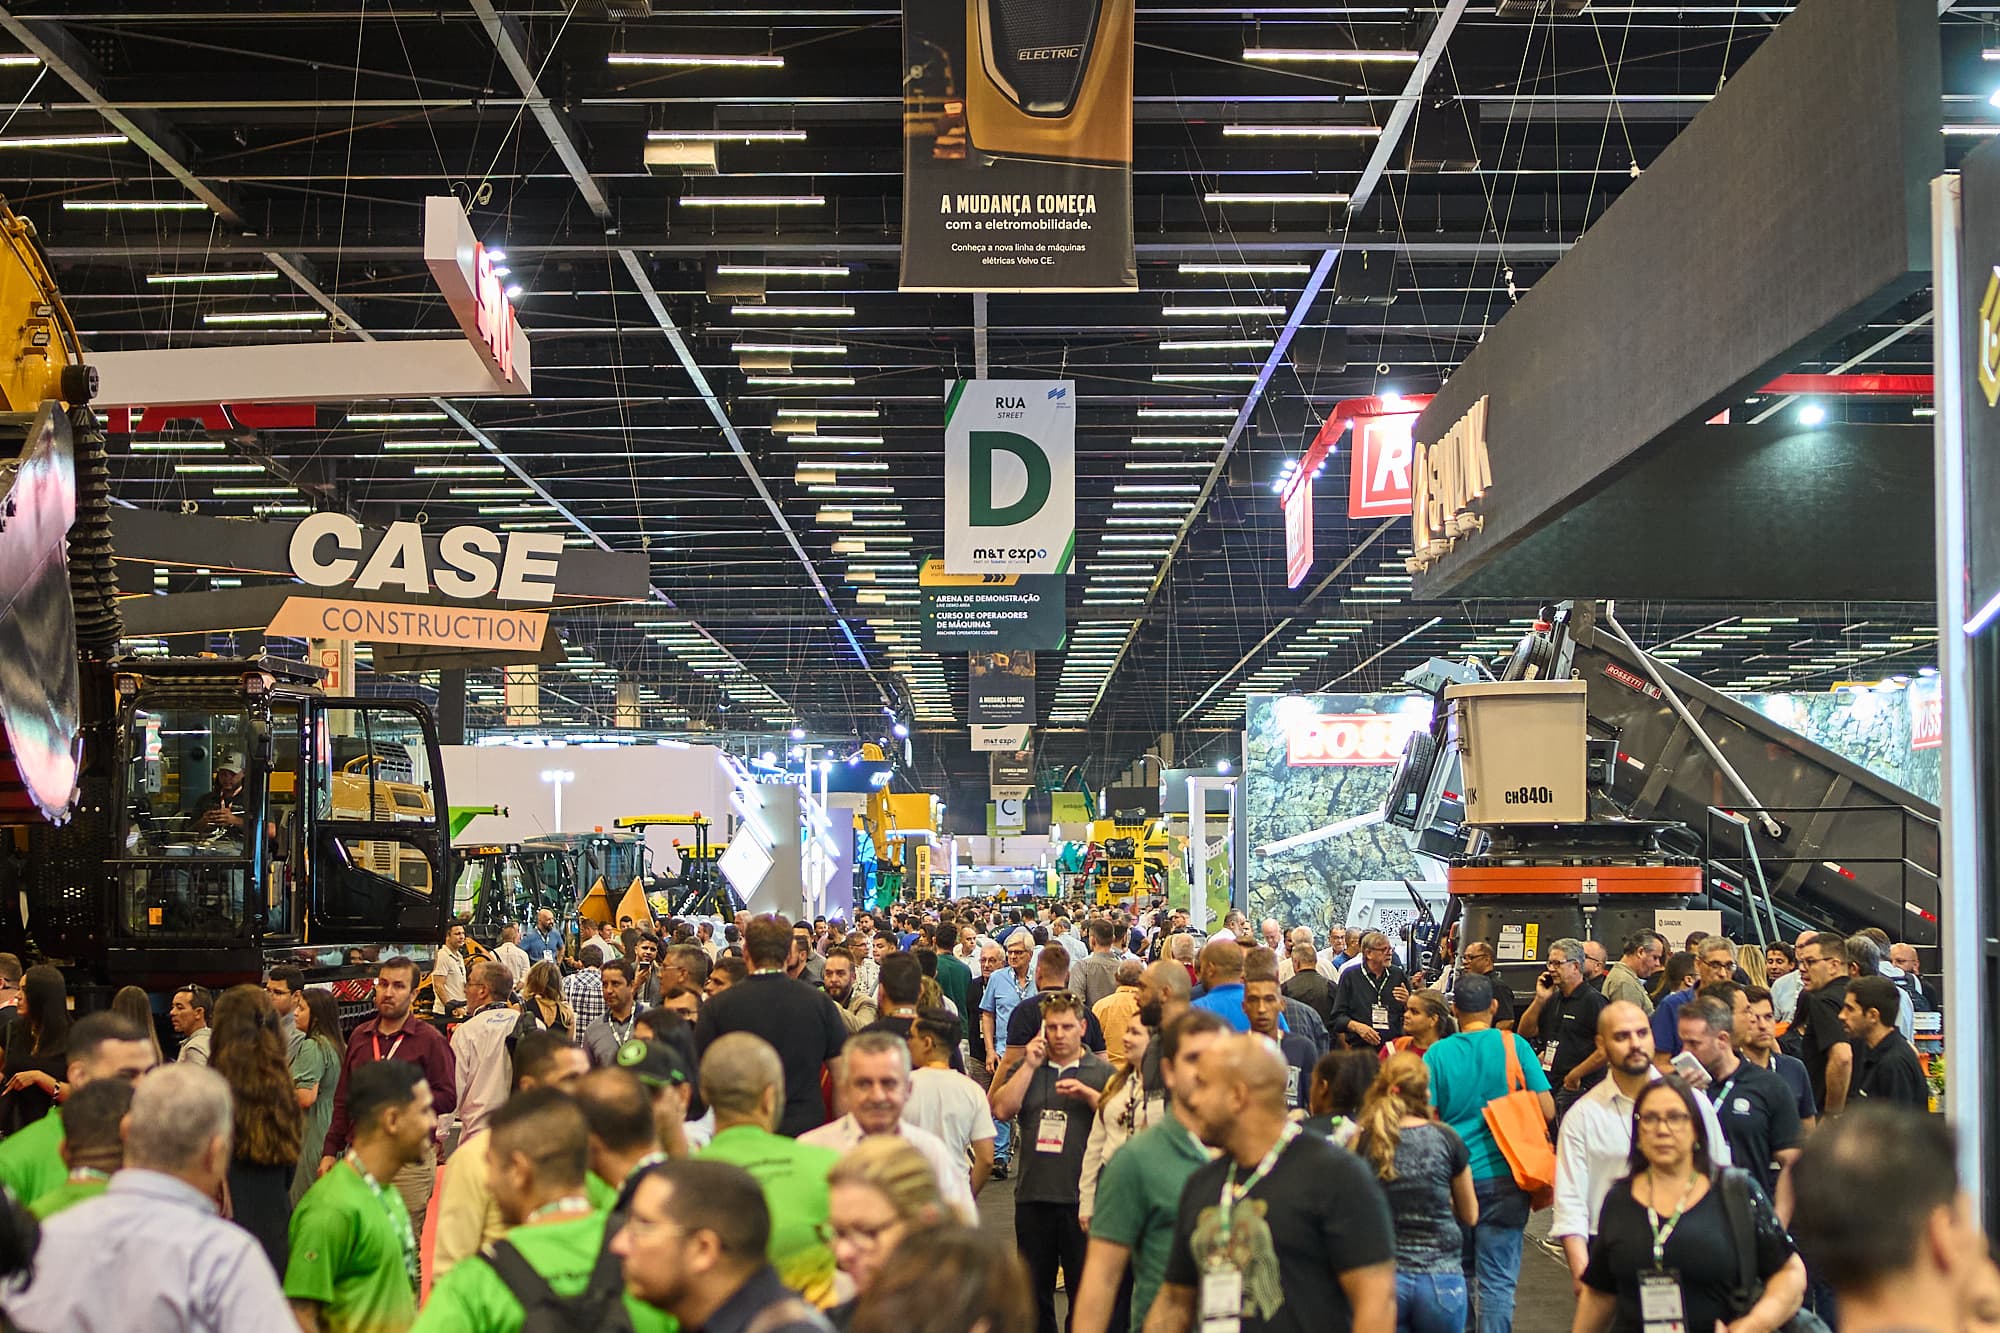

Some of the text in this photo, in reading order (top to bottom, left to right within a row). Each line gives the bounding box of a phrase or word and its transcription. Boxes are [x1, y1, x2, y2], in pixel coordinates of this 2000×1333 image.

[1018, 47, 1080, 61] ELECTRIC
[940, 194, 1097, 217] A MUDANÇA COMEÇA
[945, 218, 1092, 231] com a eletromobilidade.
[951, 243, 986, 254] Conheça
[1015, 243, 1034, 252] linha
[1036, 243, 1046, 252] de
[1047, 243, 1086, 254] máquinas
[982, 256, 1055, 265] elétricas Volvo CE.
[995, 397, 1026, 409] RUA
[969, 430, 1052, 527] D
[289, 512, 565, 603] CASE
[1008, 548, 1047, 564] expo
[975, 593, 1040, 604] DEMONSTRAÇÃO
[976, 611, 1028, 619] OPERADORES
[322, 607, 537, 643] CONSTRUCTION
[948, 620, 991, 628] MÁQUINAS
[1607, 666, 1642, 688] ROSSETTI
[1504, 787, 1553, 804] CH840i
